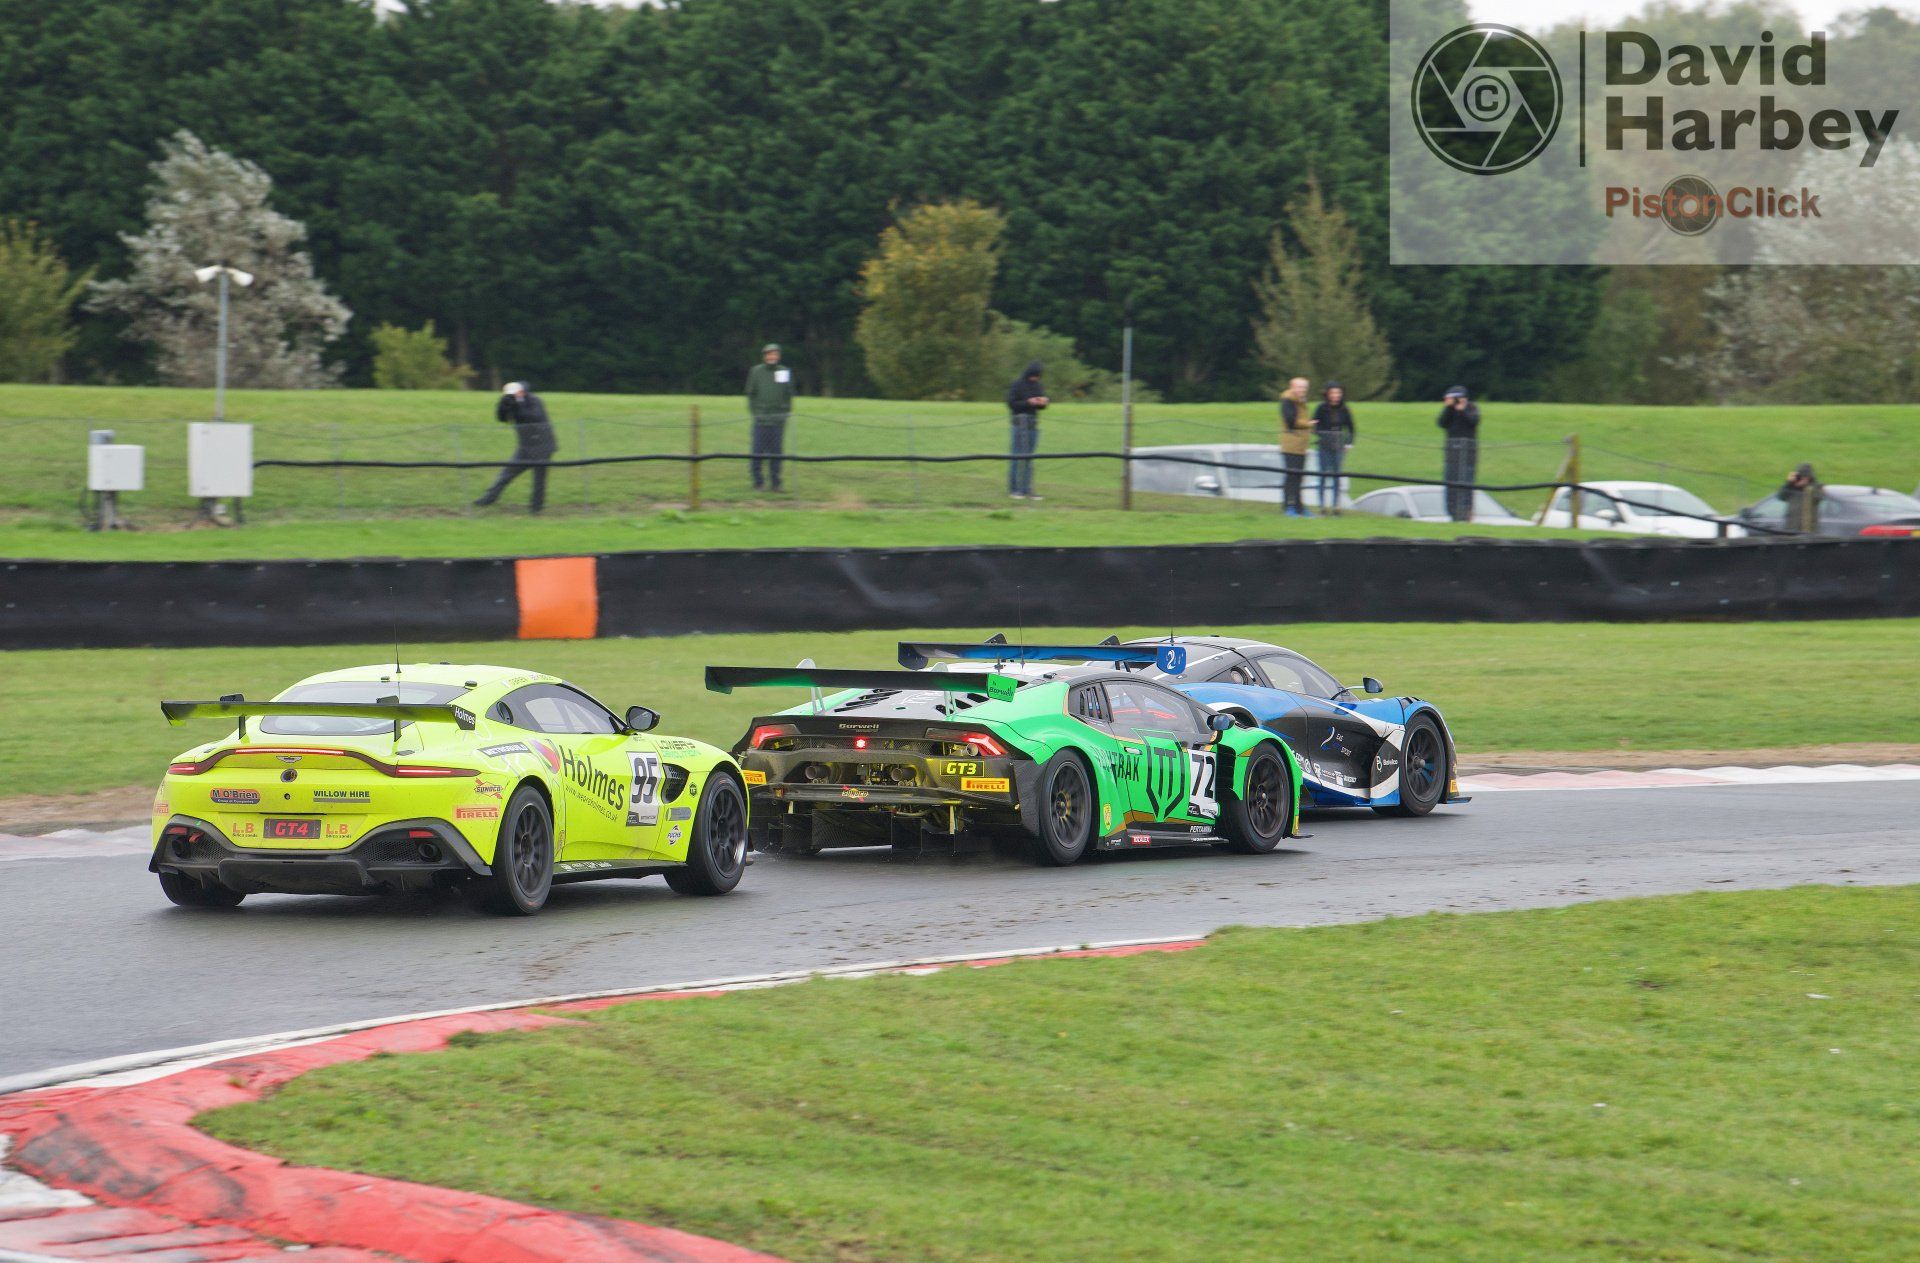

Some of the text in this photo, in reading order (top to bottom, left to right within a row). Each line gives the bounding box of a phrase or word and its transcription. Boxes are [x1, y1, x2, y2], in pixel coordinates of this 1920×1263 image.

[455, 707, 475, 725] Holmes
[946, 762, 977, 775] GT3
[1191, 753, 1215, 799] 72
[559, 744, 625, 811] Holmes
[631, 757, 658, 804] 95
[966, 780, 1006, 790] PIRELLI
[313, 790, 370, 798] WILLOW HIRE
[456, 807, 499, 818] PIRELLI
[275, 821, 309, 837] GT4
